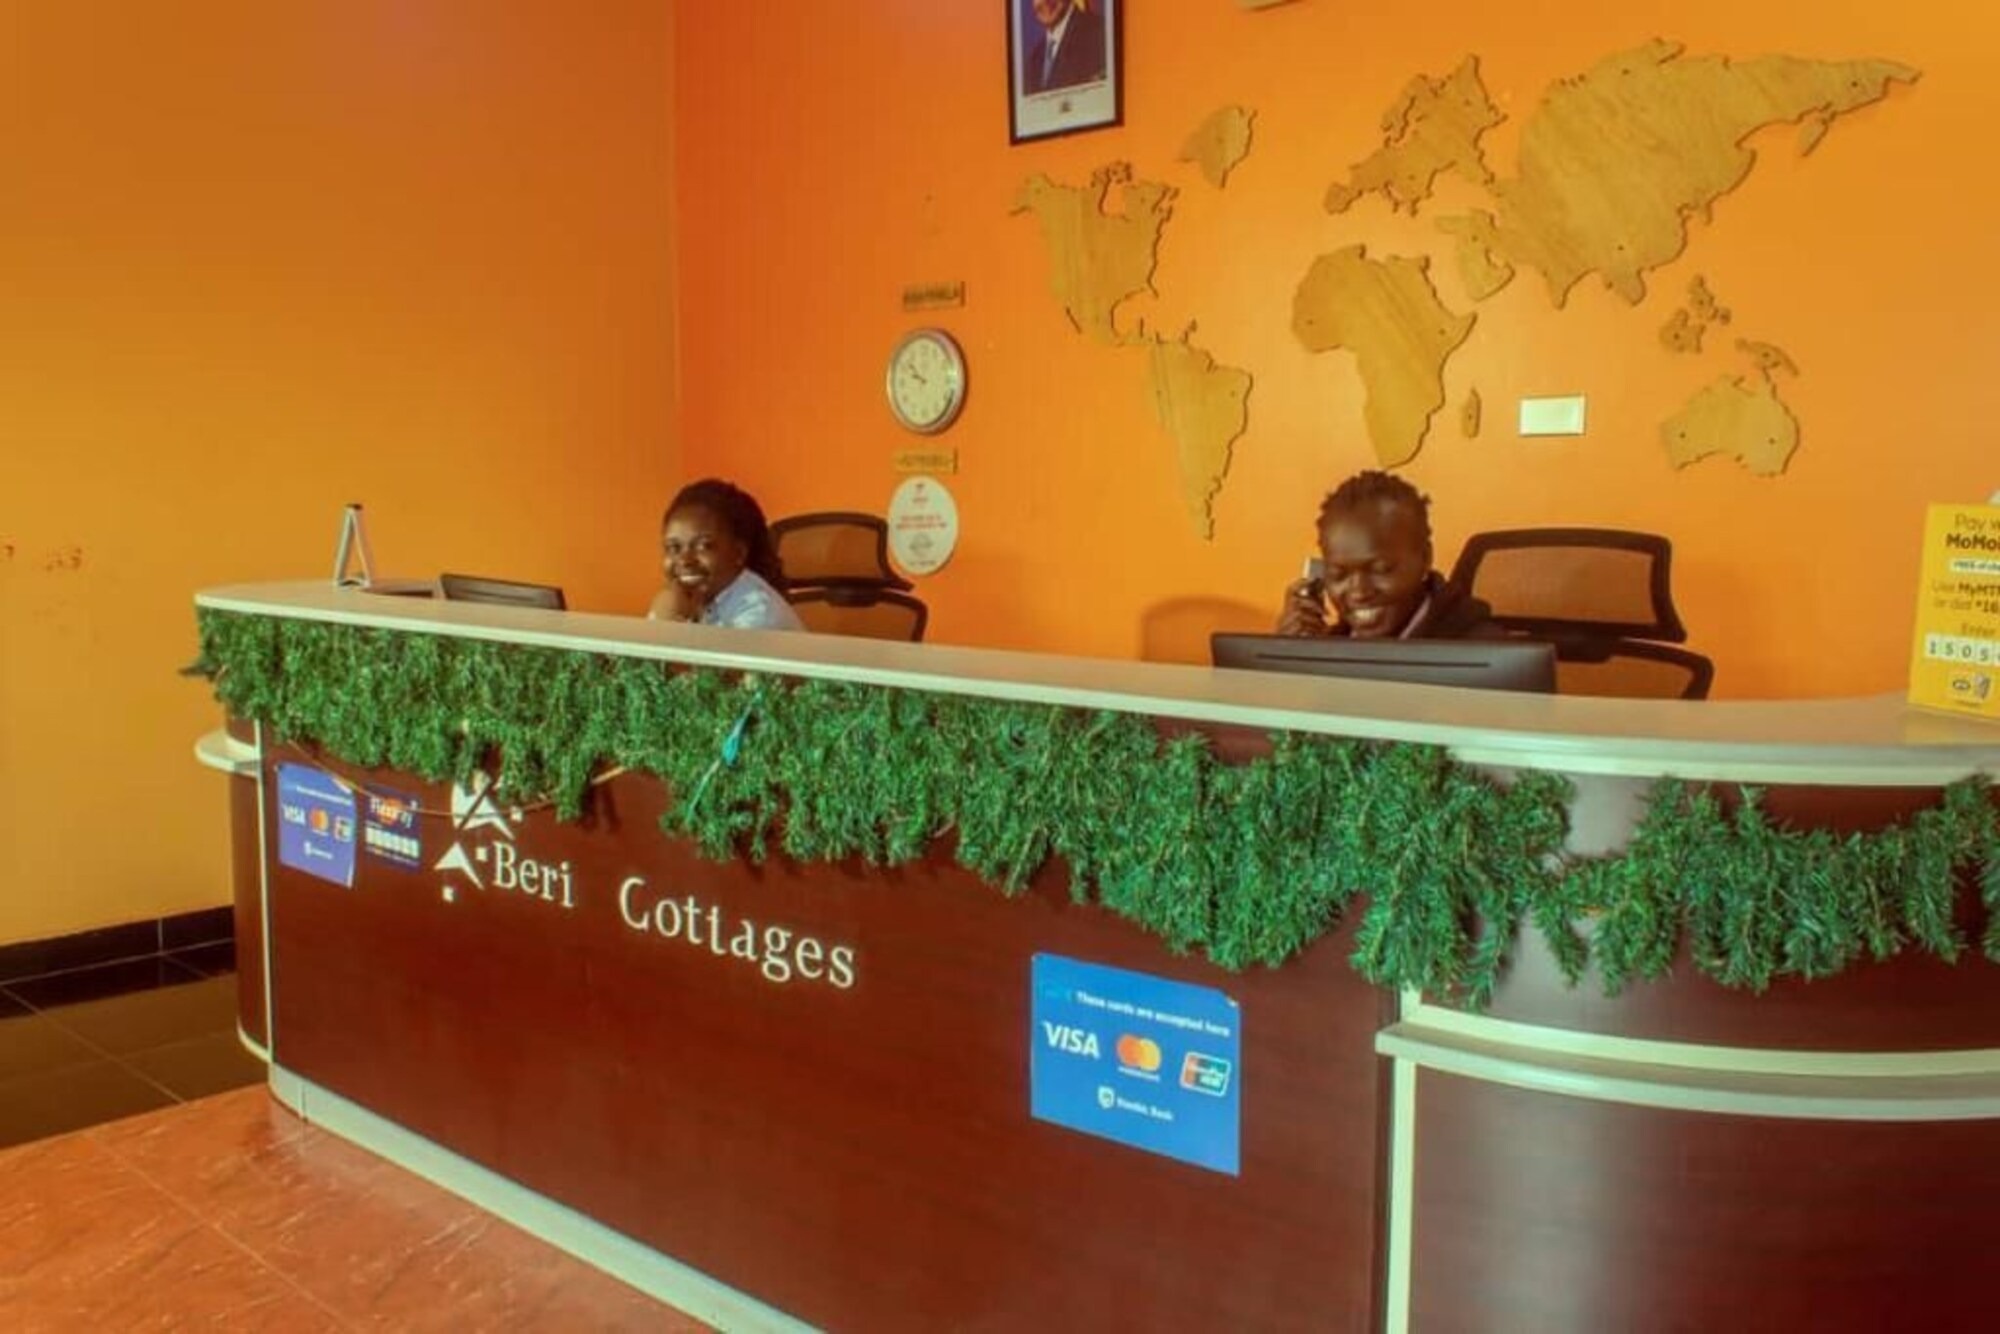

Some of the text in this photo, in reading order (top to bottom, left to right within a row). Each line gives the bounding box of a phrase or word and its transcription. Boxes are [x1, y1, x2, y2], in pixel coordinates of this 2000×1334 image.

[1954, 513, 1987, 533] Pay
[282, 803, 307, 826] VISA
[492, 840, 855, 989] Beri Cottages
[1076, 990, 1106, 1008] These
[1107, 999, 1134, 1015] cards
[1155, 1011, 1204, 1031] accepted
[1205, 1018, 1231, 1038] here
[1042, 1020, 1101, 1060] VISA
